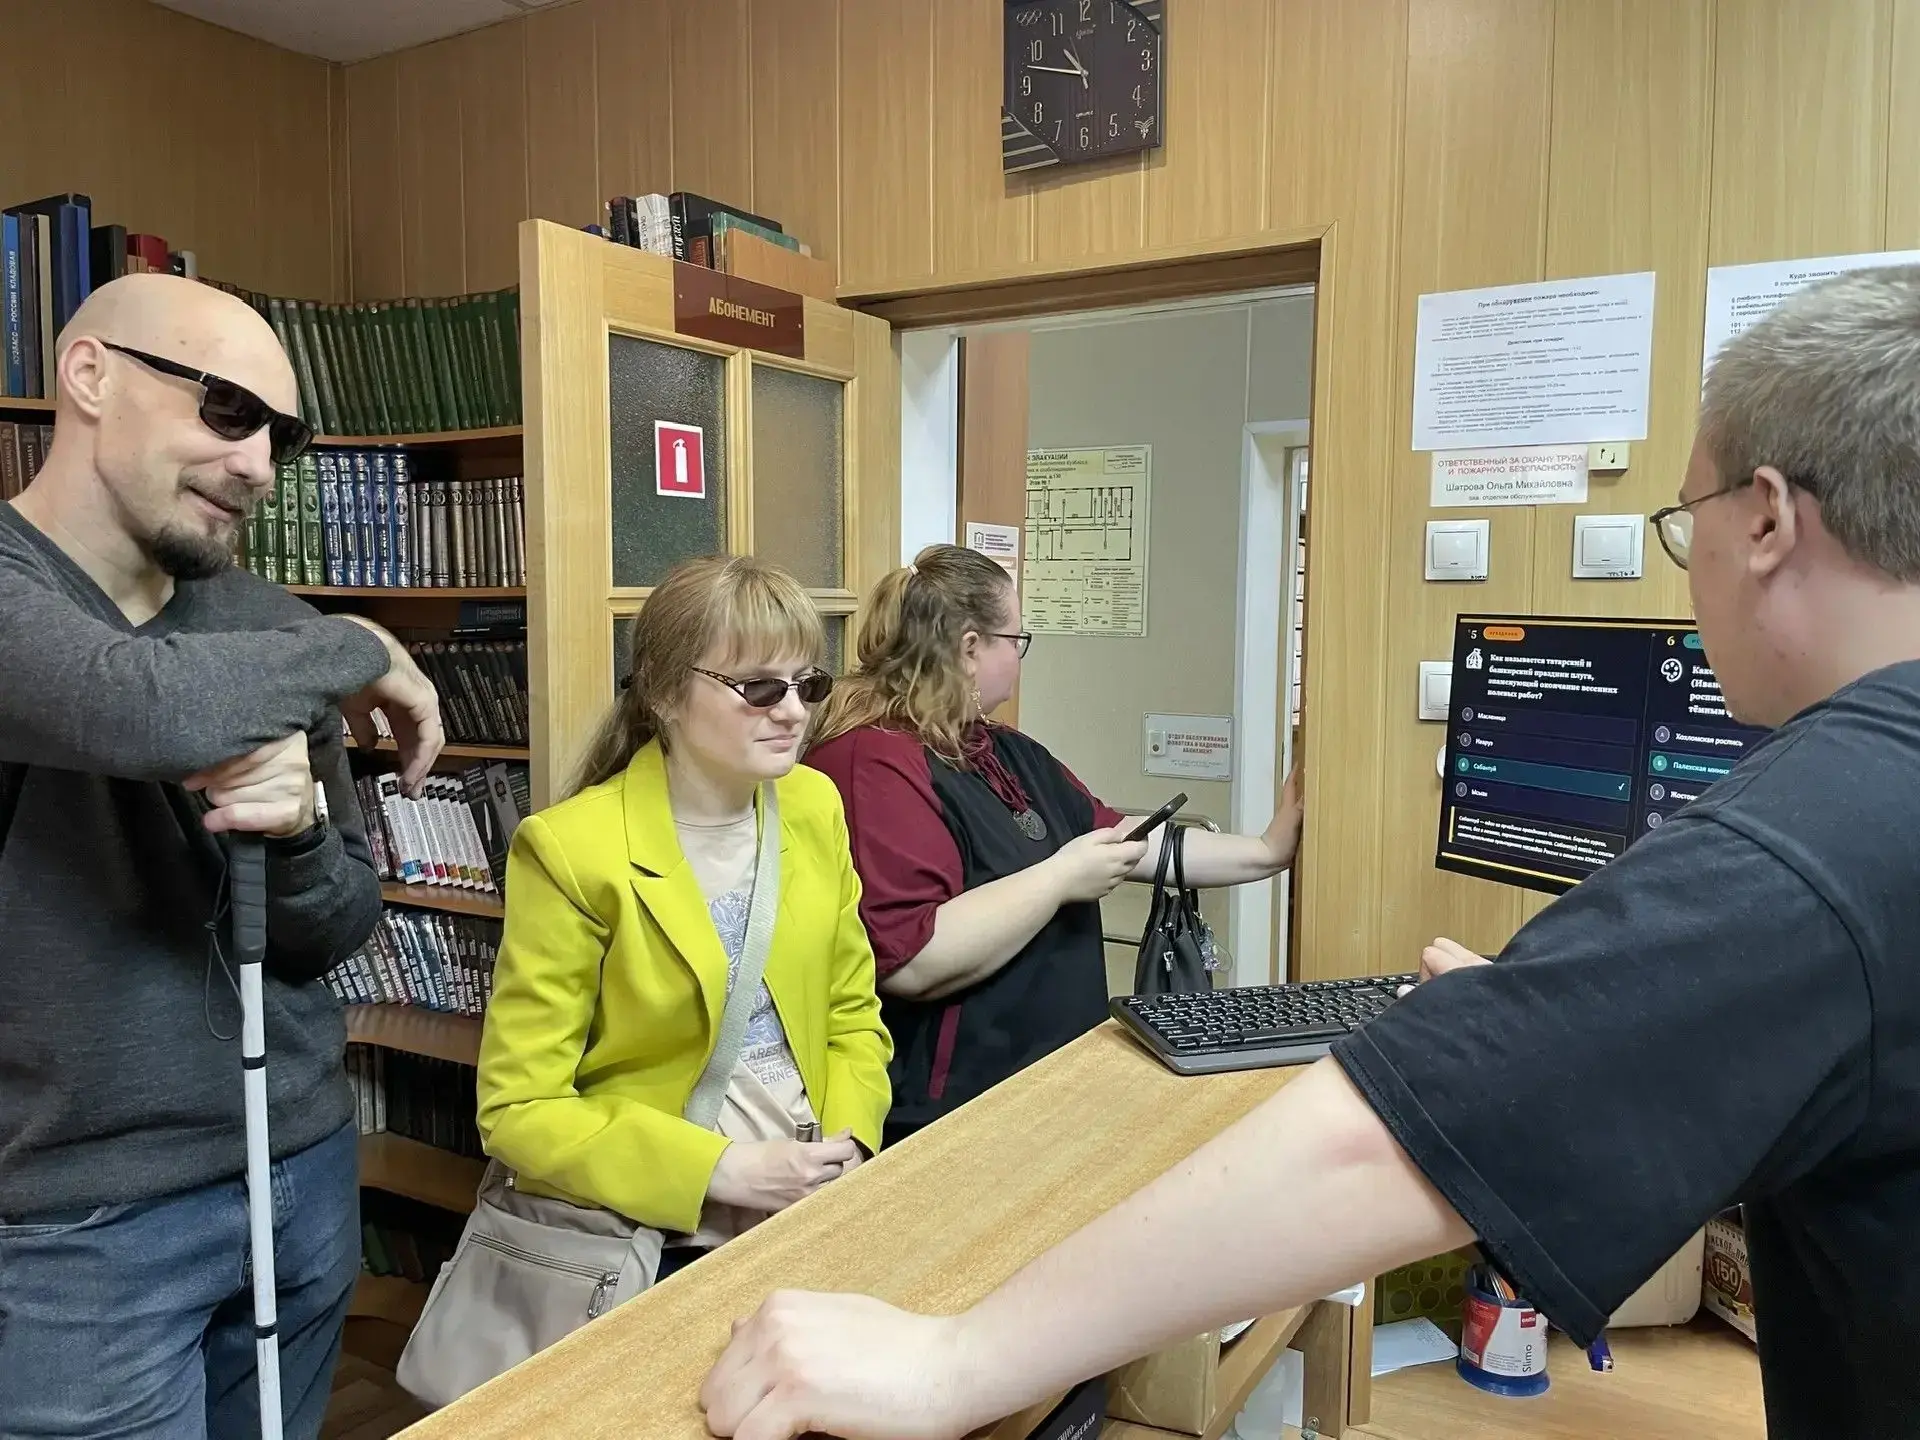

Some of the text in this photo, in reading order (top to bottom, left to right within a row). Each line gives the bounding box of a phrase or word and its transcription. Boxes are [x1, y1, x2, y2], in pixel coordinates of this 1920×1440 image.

[1080, 0, 1091, 22] 12
[1109, 2, 1114, 24] 1
[1051, 12, 1063, 36] 11
[1127, 20, 1136, 42] 2
[1031, 40, 1042, 62] 10
[1142, 50, 1150, 70] 3
[1022, 76, 1031, 96] 9
[1132, 85, 1141, 107] 4
[1034, 102, 1042, 124] 8
[1055, 120, 1062, 141] 7
[1110, 114, 1118, 136] 5
[1080, 127, 1088, 148] 6
[709, 297, 776, 327] АБОНЕМЕНТ
[1438, 457, 1508, 468] ОТВЕТСТВЕННЫЙ
[1522, 456, 1554, 464] ОХРАНУ
[1556, 454, 1584, 463] ТРУДА
[1457, 466, 1506, 475] ПОЖАРНУЮ
[1509, 464, 1576, 472] БЕЗОПАСНОСТЬ
[1446, 480, 1574, 492] Шатрова Ольга Михайловна
[1470, 630, 1478, 639] 5
[1666, 636, 1675, 646] 6
[1490, 654, 1504, 662] Как
[1504, 656, 1546, 664] называется
[1546, 658, 1585, 668] татарский
[1534, 670, 1570, 679] праздник
[1488, 689, 1542, 700] полевых работ?
[1540, 682, 1580, 691] окончание
[1581, 685, 1618, 694] весенних
[1688, 704, 1726, 716] тёмным
[1676, 733, 1744, 746] Хохломская роспись
[740, 1042, 785, 1062] EAREST
[760, 1065, 799, 1085] ERNE
[1714, 1258, 1738, 1287] 150
[1522, 1344, 1532, 1373] Slimo
